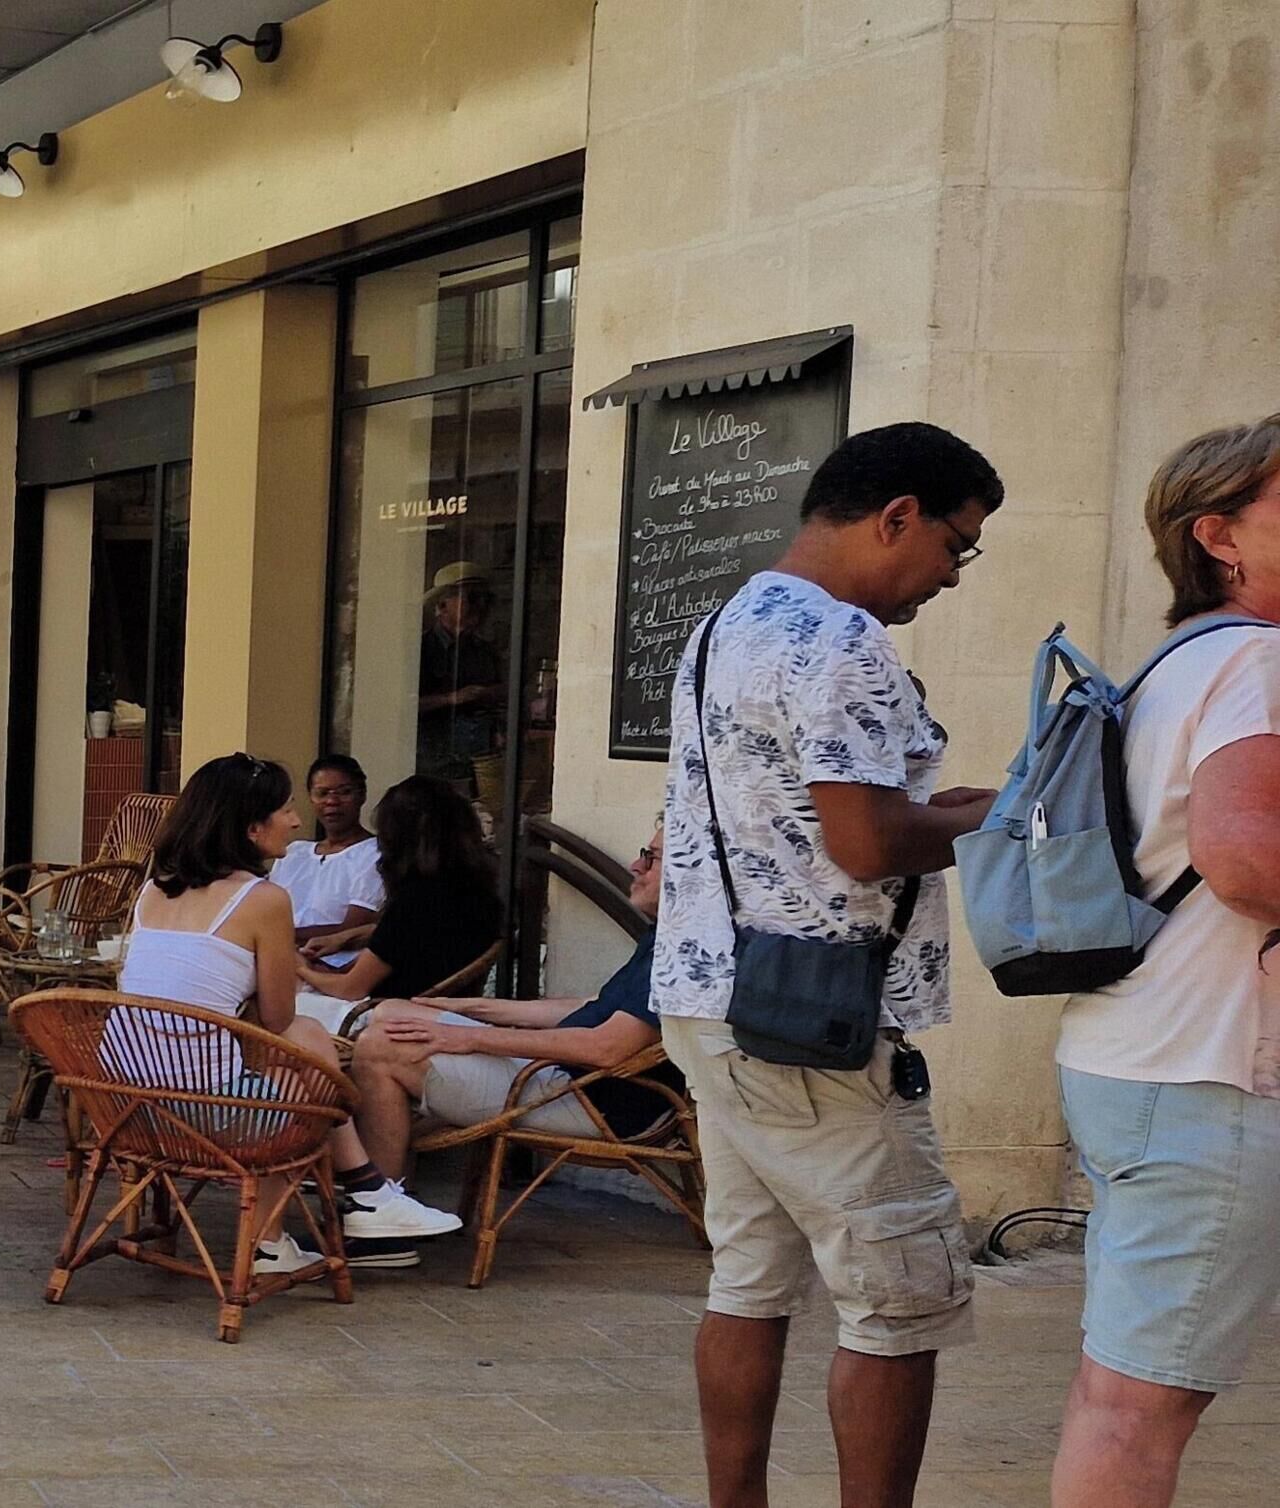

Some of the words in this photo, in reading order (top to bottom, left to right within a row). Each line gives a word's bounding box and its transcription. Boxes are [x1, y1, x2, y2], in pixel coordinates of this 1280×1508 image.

[668, 419, 690, 455] Le
[697, 409, 768, 460] Village
[686, 475, 702, 491] du
[735, 471, 752, 483] au
[754, 456, 811, 483] Dimanche
[379, 503, 397, 519] LE
[402, 496, 468, 517] VILLAGE
[679, 497, 695, 516] de
